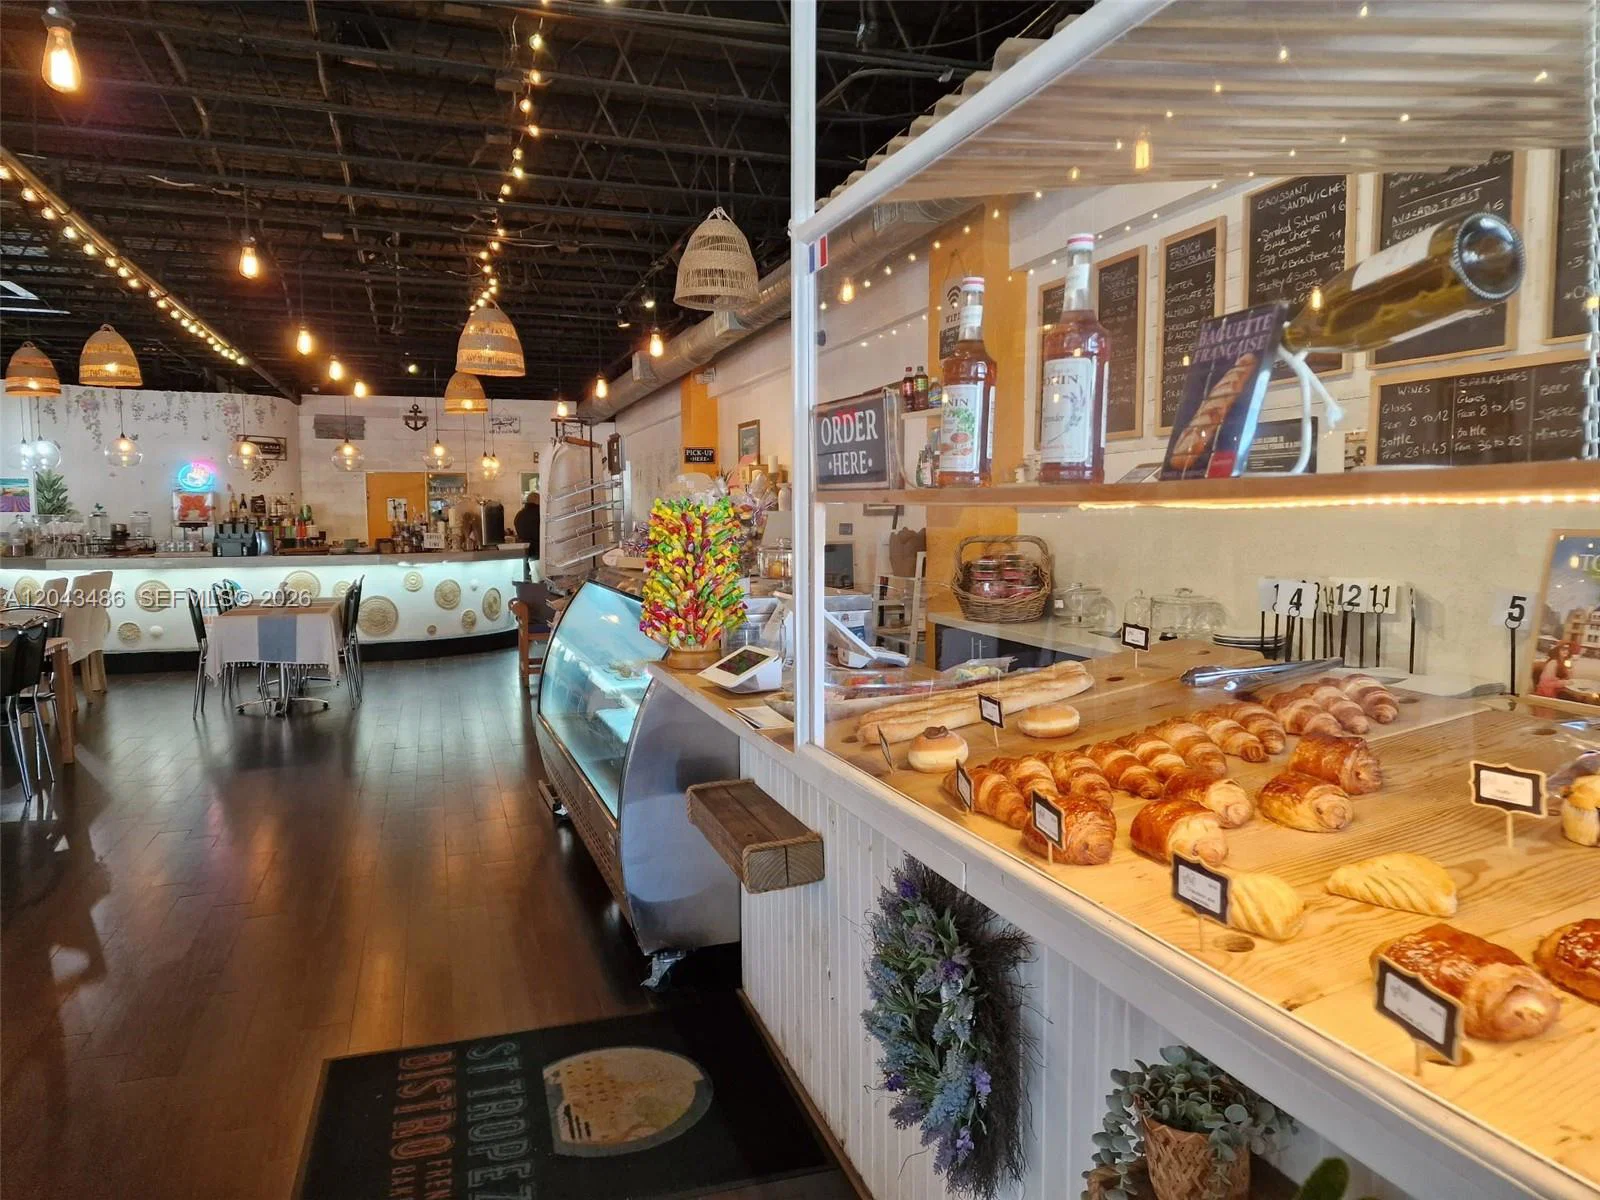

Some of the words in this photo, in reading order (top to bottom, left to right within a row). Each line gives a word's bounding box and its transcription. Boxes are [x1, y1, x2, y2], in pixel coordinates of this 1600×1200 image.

[821, 409, 878, 446] ORDER
[832, 450, 868, 476] HERE
[1289, 588, 1303, 611] 4
[1336, 584, 1362, 607] 12
[1370, 584, 1391, 608] 11
[1508, 596, 1527, 622] 5
[389, 1050, 455, 1159] BISTRO
